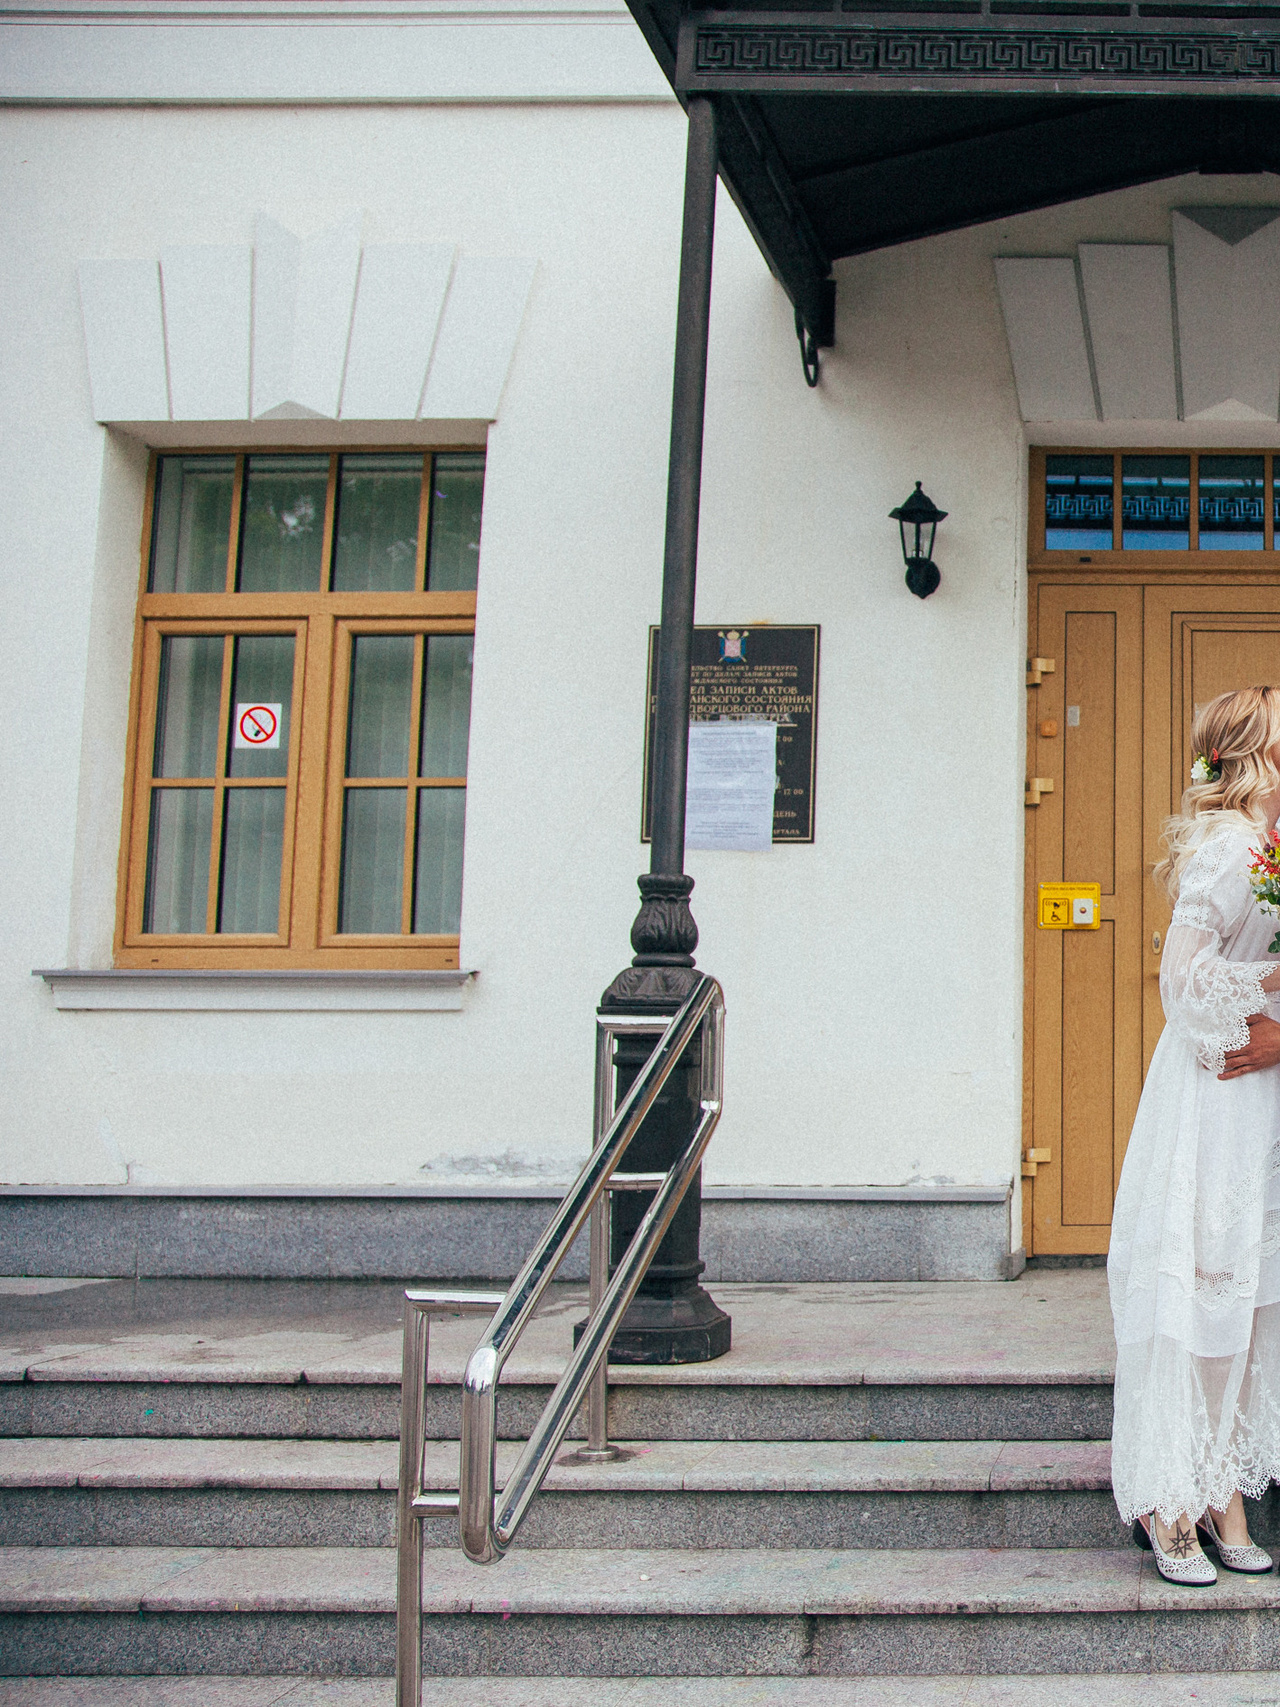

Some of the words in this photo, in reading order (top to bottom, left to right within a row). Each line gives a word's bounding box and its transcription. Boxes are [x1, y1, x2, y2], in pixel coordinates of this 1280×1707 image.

[710, 685, 756, 695] ЗАПИСИ
[761, 685, 798, 695] АКТОВ
[744, 695, 812, 704] СОСТОЯНИЯ
[766, 703, 810, 713] РАЙОНА
